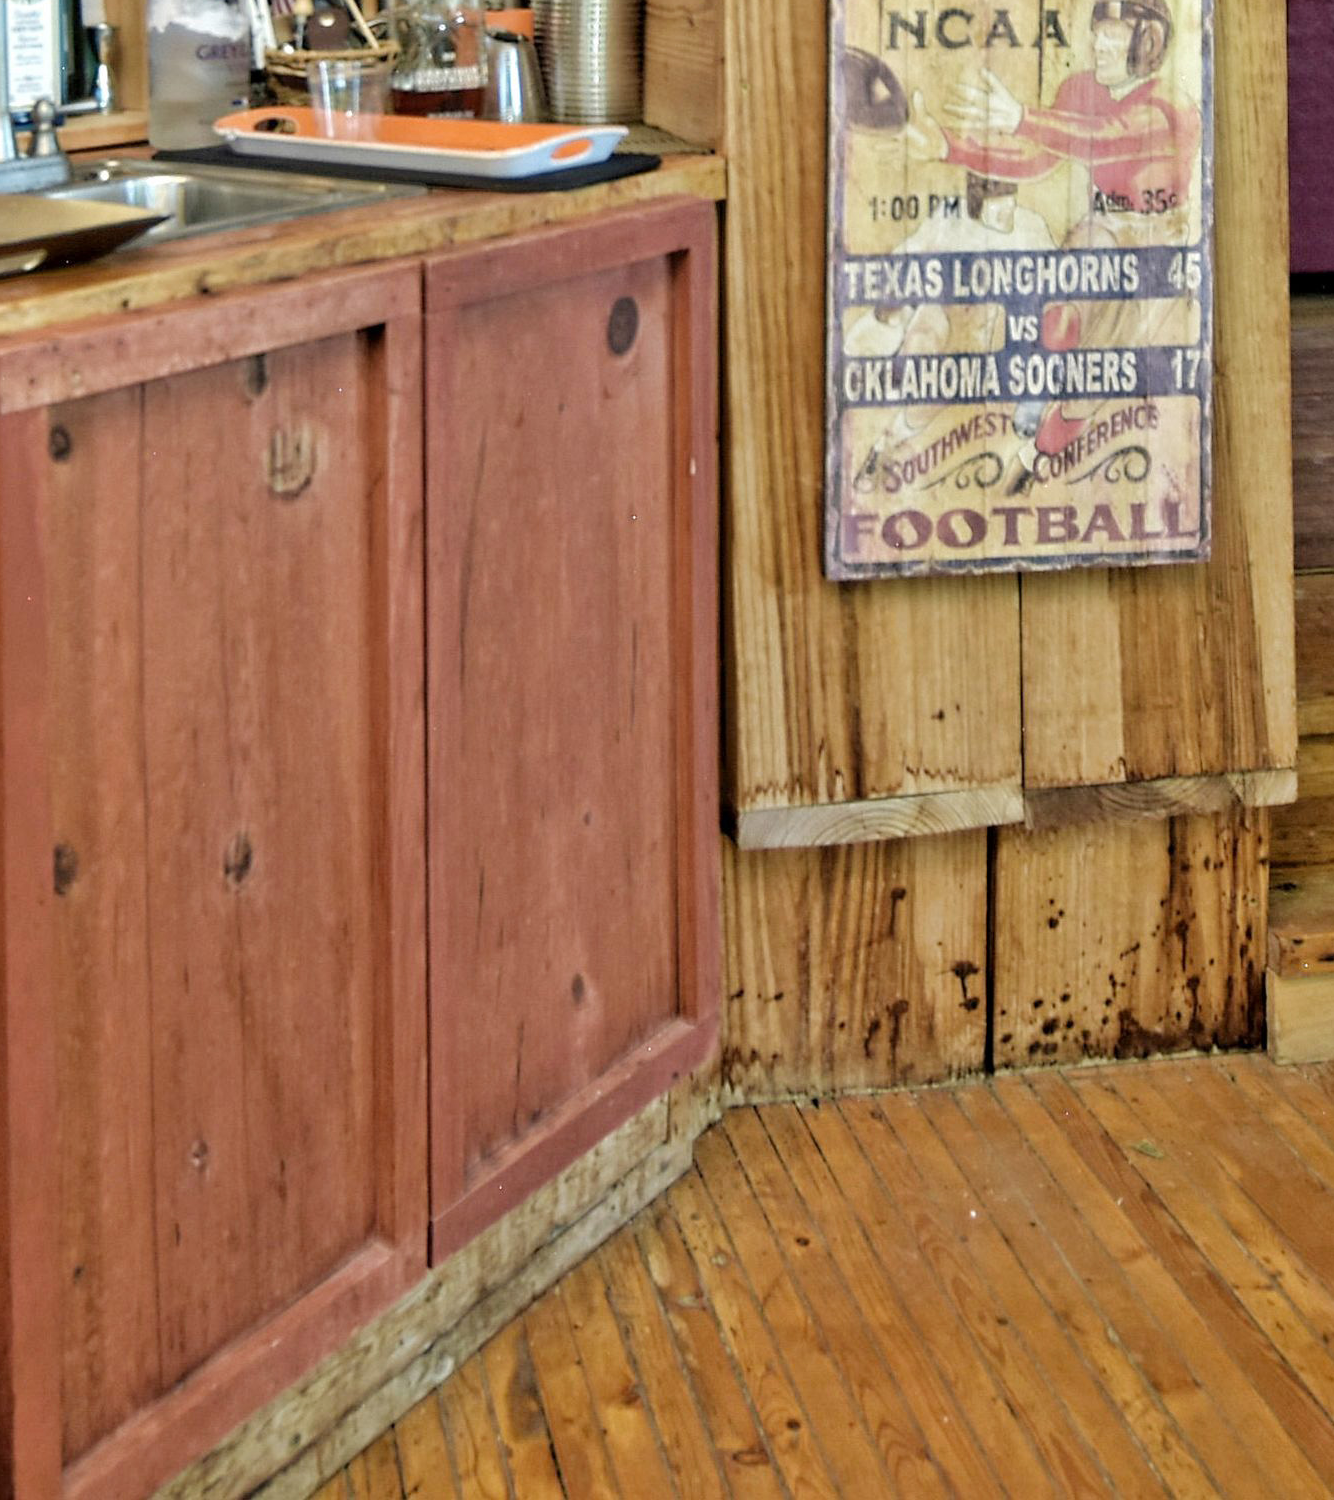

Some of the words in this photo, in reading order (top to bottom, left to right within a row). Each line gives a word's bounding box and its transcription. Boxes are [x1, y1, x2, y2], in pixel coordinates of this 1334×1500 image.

[885, 8, 1071, 50] NCAA
[870, 195, 919, 221] 1:00
[928, 194, 961, 221] PM
[844, 259, 943, 299] TEXAS
[953, 252, 1139, 297] LONGHORNS
[1169, 252, 1201, 291] 45
[1010, 315, 1039, 342] VS
[844, 355, 1000, 401] OKLAHOMA
[1009, 351, 1138, 396] SOONERS
[1171, 350, 1200, 389] 17
[883, 411, 1013, 494] SOUTHWEST
[1032, 403, 1159, 484] CONFERENCE
[843, 500, 1200, 555] FOOTBALL
